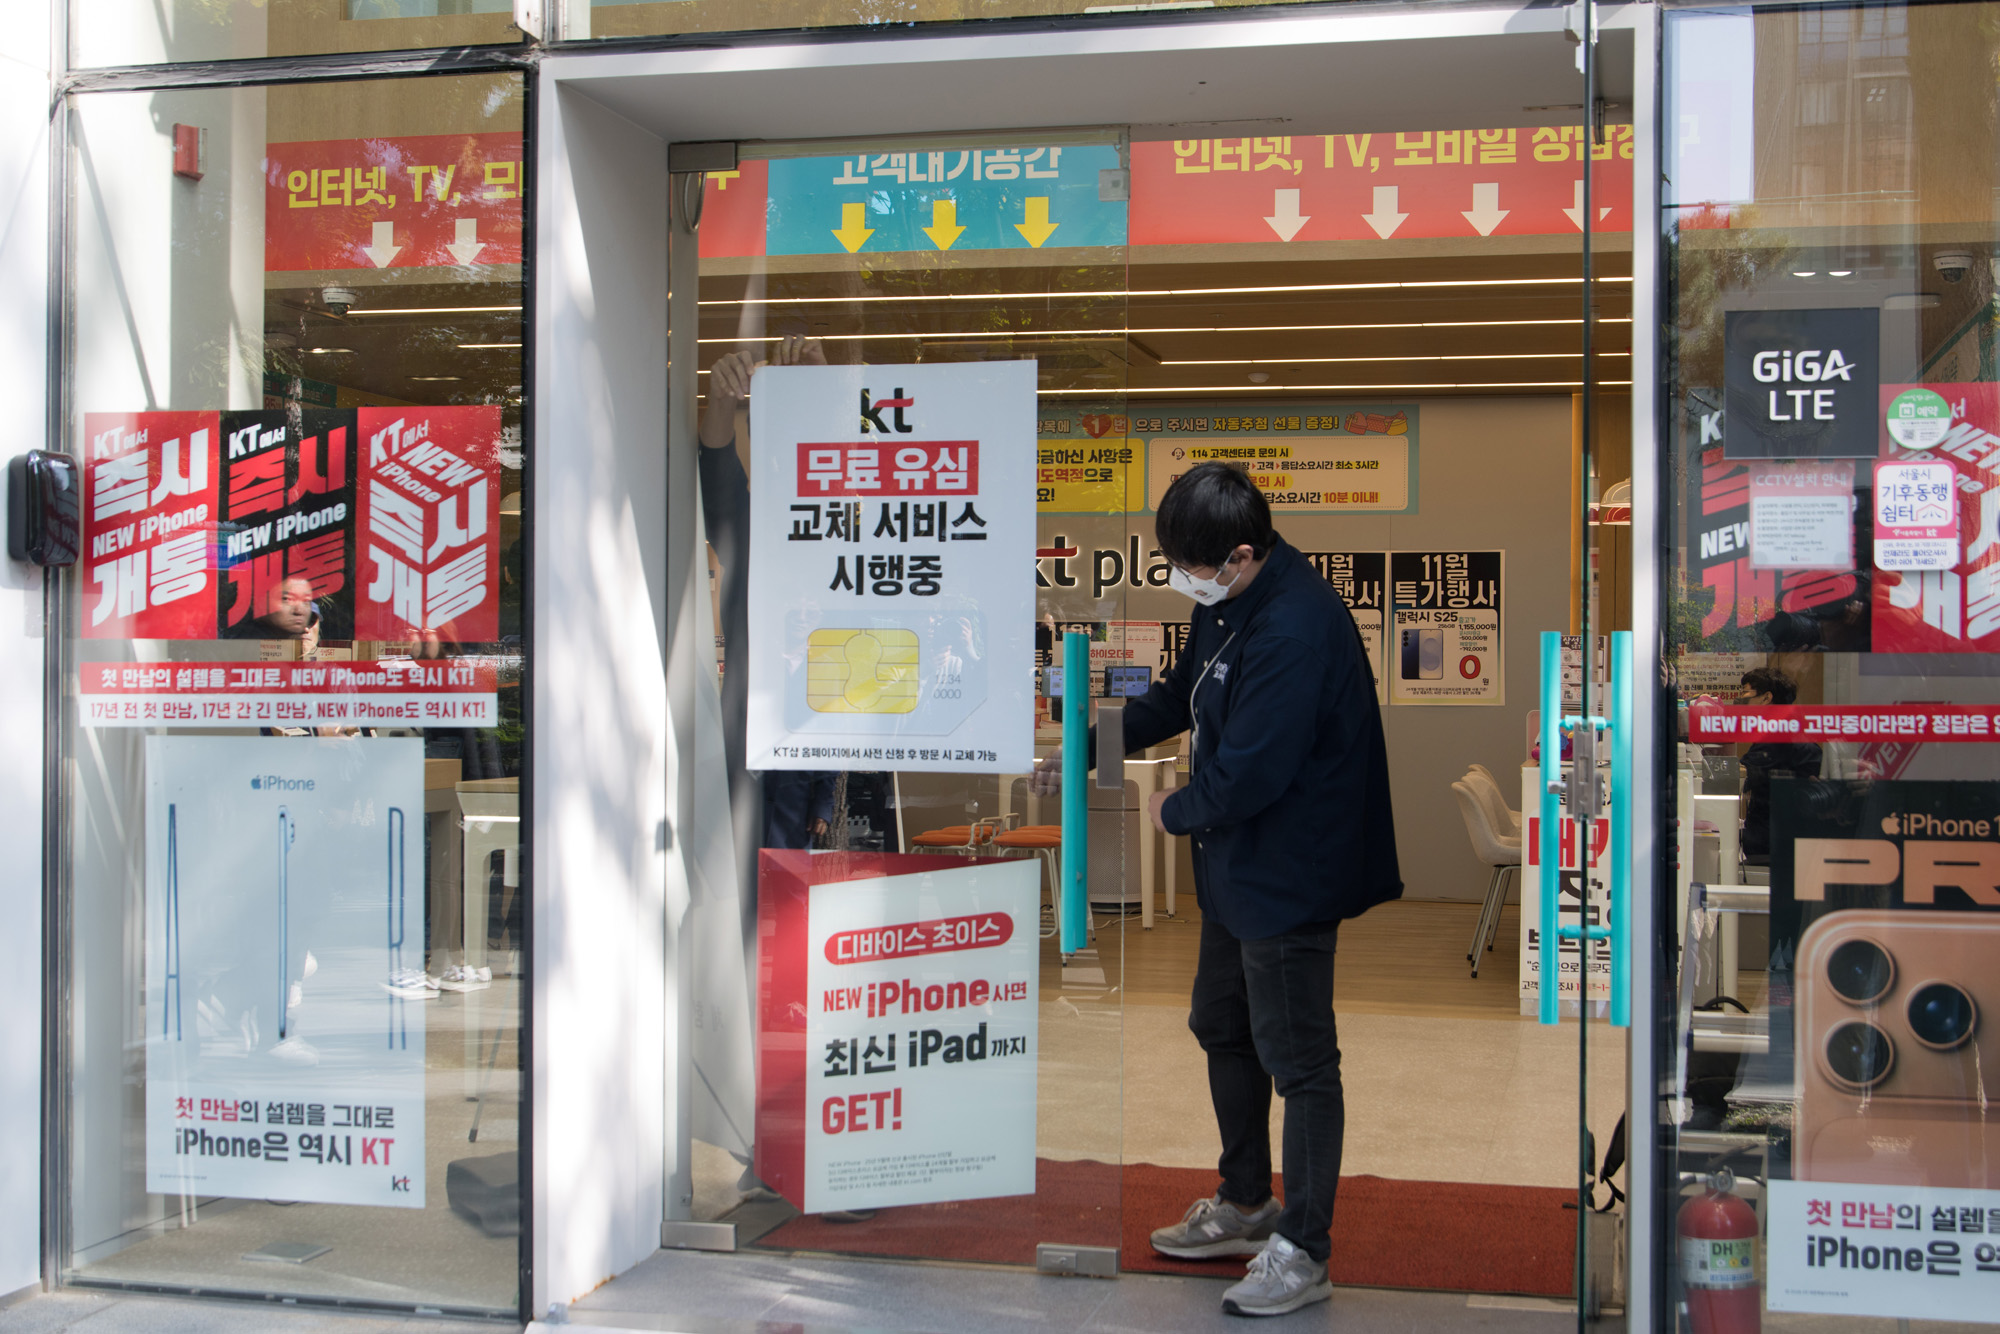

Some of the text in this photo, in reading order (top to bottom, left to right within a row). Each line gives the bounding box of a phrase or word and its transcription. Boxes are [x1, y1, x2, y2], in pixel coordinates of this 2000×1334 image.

[1174, 136, 1302, 176] 인터넷,
[1316, 134, 1379, 173] TV,
[1394, 128, 1516, 166] 모바일
[287, 161, 523, 209] 인터넷, TV, 모
[860, 388, 914, 434] kt
[1769, 389, 1835, 421] LTE
[1917, 406, 1938, 416] 예약
[1136, 418, 1163, 432] 으로
[1168, 418, 1208, 432] 주시면
[1213, 416, 1268, 431] 자동추첨
[1273, 416, 1302, 430] 선물
[1306, 415, 1339, 430] 증정!
[1700, 410, 1724, 446] K
[228, 423, 286, 460] KT에서
[1191, 448, 1289, 458] 114 고객센터로 문의 시
[399, 440, 485, 488] NEW
[806, 446, 968, 490] 무료 유심
[1088, 448, 1132, 464] 사항은
[1257, 460, 1379, 470] 고객 응답소요시간 최소 3시간
[94, 428, 208, 522] 즉시
[228, 426, 347, 522] 즉시
[377, 462, 442, 503] iPhone
[1037, 468, 1113, 483] 도역점으로
[1274, 476, 1286, 488] 시
[1755, 472, 1847, 488] CCTV설치 안내
[1898, 468, 1931, 481] 서울시
[1323, 492, 1348, 504] 10분
[1352, 492, 1378, 504] 이내!
[1881, 483, 1948, 502] 기후동행
[369, 477, 488, 566] 즉시
[788, 501, 987, 543] 교체 서비스
[1881, 504, 1914, 522] 쉼터
[92, 504, 208, 559] NEW iPhone
[227, 522, 272, 558] NEW
[276, 502, 347, 542] iPhone
[1926, 528, 1937, 537] kt
[92, 530, 208, 627] 개통
[228, 529, 345, 628] 개통
[829, 555, 943, 596] 시행중
[1422, 554, 1468, 582] 11월
[368, 543, 487, 630] 개통
[1395, 580, 1496, 608] 특가행사
[1396, 612, 1458, 624] 갤럭시 S25
[1090, 649, 1134, 658] 하이오더로
[1459, 655, 1481, 679] 0
[101, 668, 475, 689] 첫 만남의 설렘을 그대로, NEW iPhone도 역시 KT!
[1483, 678, 1489, 686] 원
[933, 688, 962, 699] 0000
[90, 701, 486, 720] 17년 전 첫 만남, 17년 간 긴 만남, NEW iPhone도 역시 KT!
[1700, 716, 1737, 733] NEW
[1742, 716, 1799, 733] iPhone
[1804, 715, 1926, 734] 고민중이라면?
[1932, 715, 1988, 734] 정답은
[802, 747, 860, 758] 홈페이지에서
[863, 748, 882, 759] 사전
[885, 748, 904, 760] 신청
[908, 749, 917, 760] 후
[920, 749, 939, 760] 방문
[942, 750, 952, 760] 시
[955, 750, 974, 760] 교체
[977, 750, 997, 761] 가능
[263, 775, 315, 791] iPhone
[1903, 813, 1990, 836] iPhone
[838, 918, 1000, 960] 디바이스 초이스
[824, 987, 862, 1012] NEW
[867, 978, 989, 1018] iPhone
[824, 1034, 896, 1077] 최신
[175, 1097, 395, 1129] 첫 만남의 설렘을 그대로
[822, 1087, 902, 1135] GET!
[175, 1128, 395, 1166] iPhone은 역시 KT
[392, 1175, 410, 1192] kt
[1807, 1200, 1831, 1226] 첫
[1842, 1202, 1921, 1230] 만남의
[1712, 1242, 1733, 1255] DH
[1807, 1235, 1961, 1276] iPhone은
